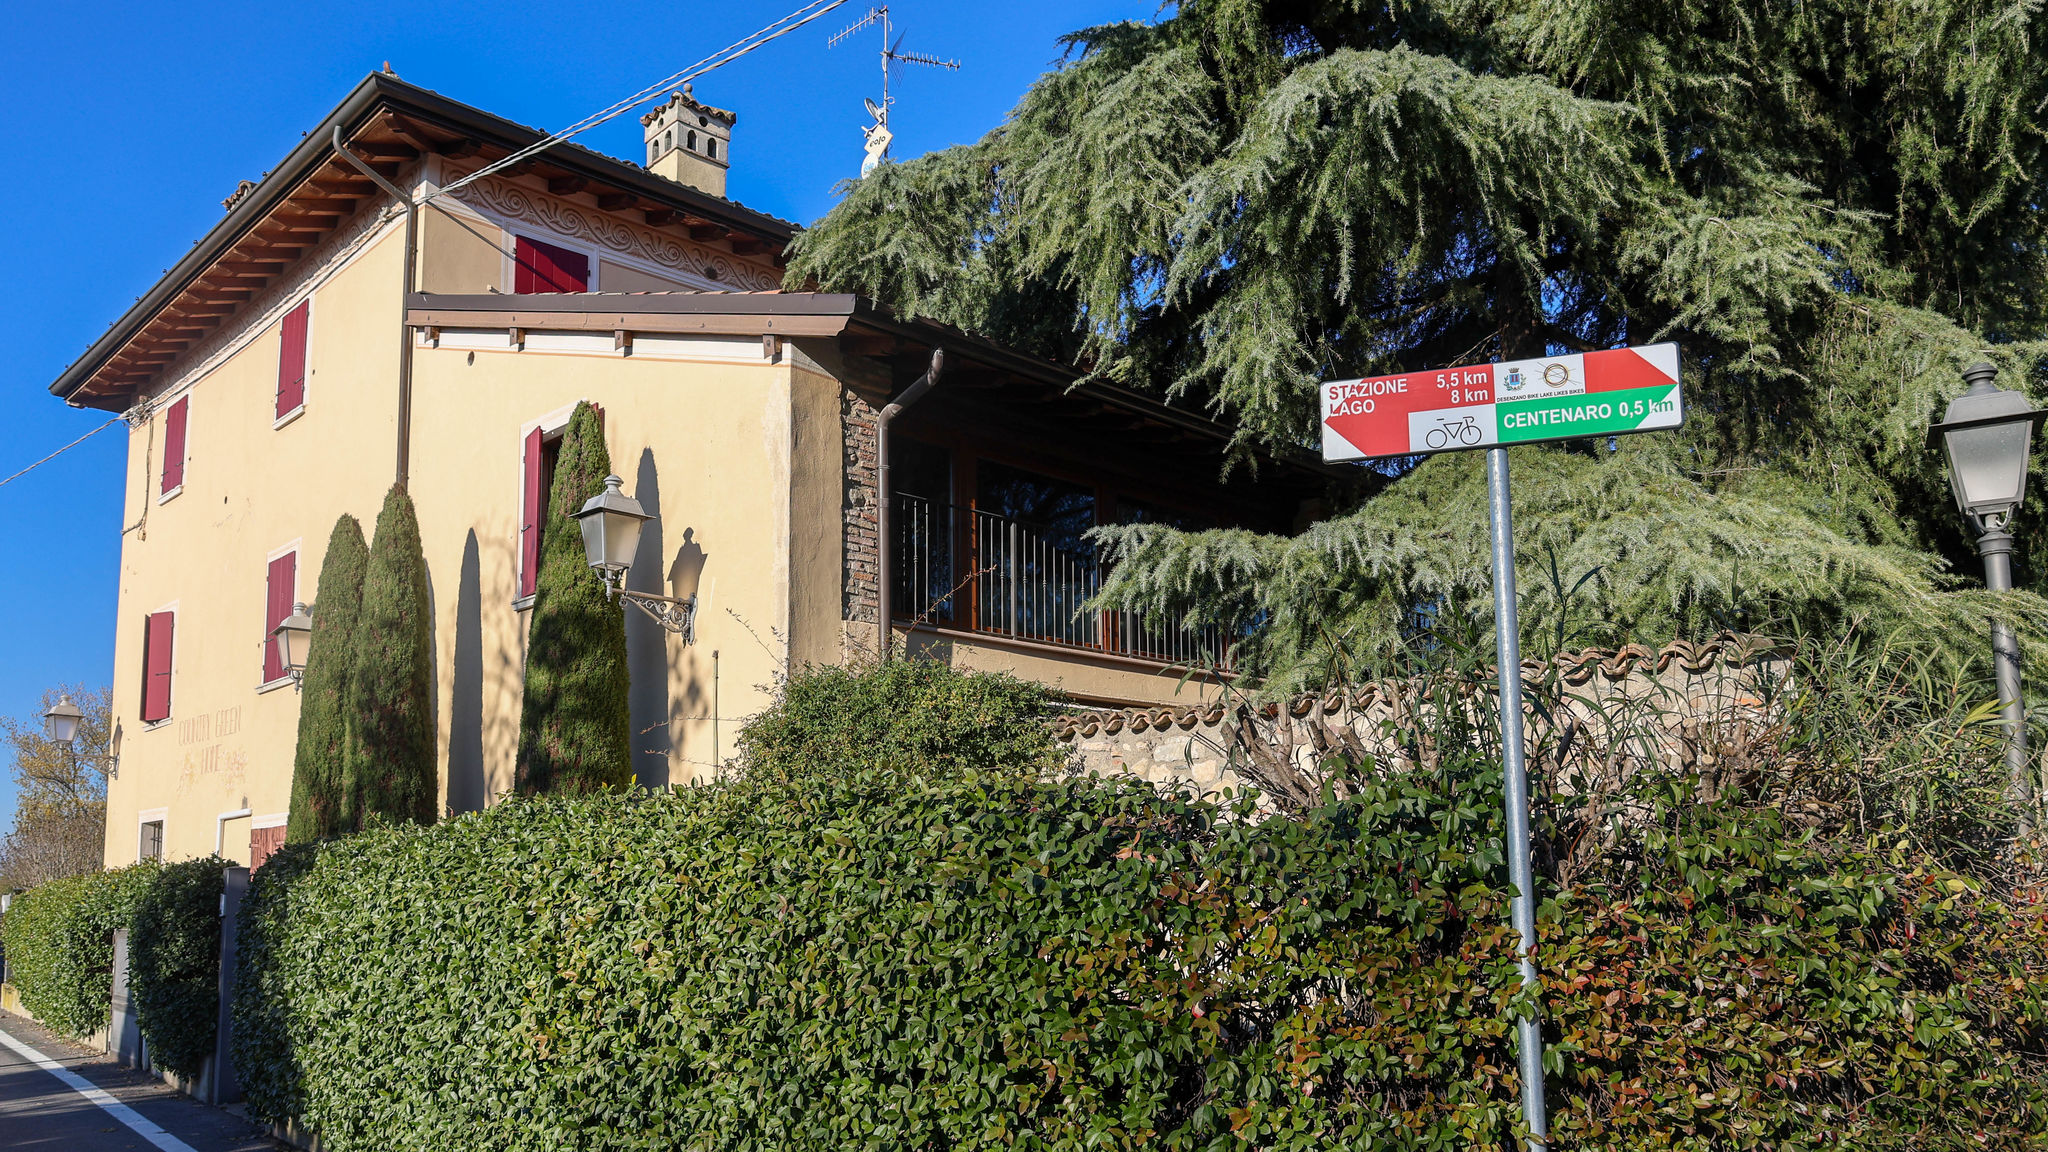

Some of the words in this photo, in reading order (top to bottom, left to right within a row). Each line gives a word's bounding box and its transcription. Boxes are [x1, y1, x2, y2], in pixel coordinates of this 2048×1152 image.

[870, 135, 886, 147] eolo
[1329, 379, 1408, 400] STAZIONE
[1436, 374, 1459, 390] 5,5
[1463, 372, 1487, 386] km
[1496, 394, 1526, 402] DESENZANO
[1329, 399, 1375, 417] LAGO
[1451, 391, 1460, 404] 8
[1465, 389, 1488, 402] km
[1503, 403, 1611, 429] CENTENARO
[1619, 400, 1644, 418] 0,5
[1648, 399, 1673, 414] km
